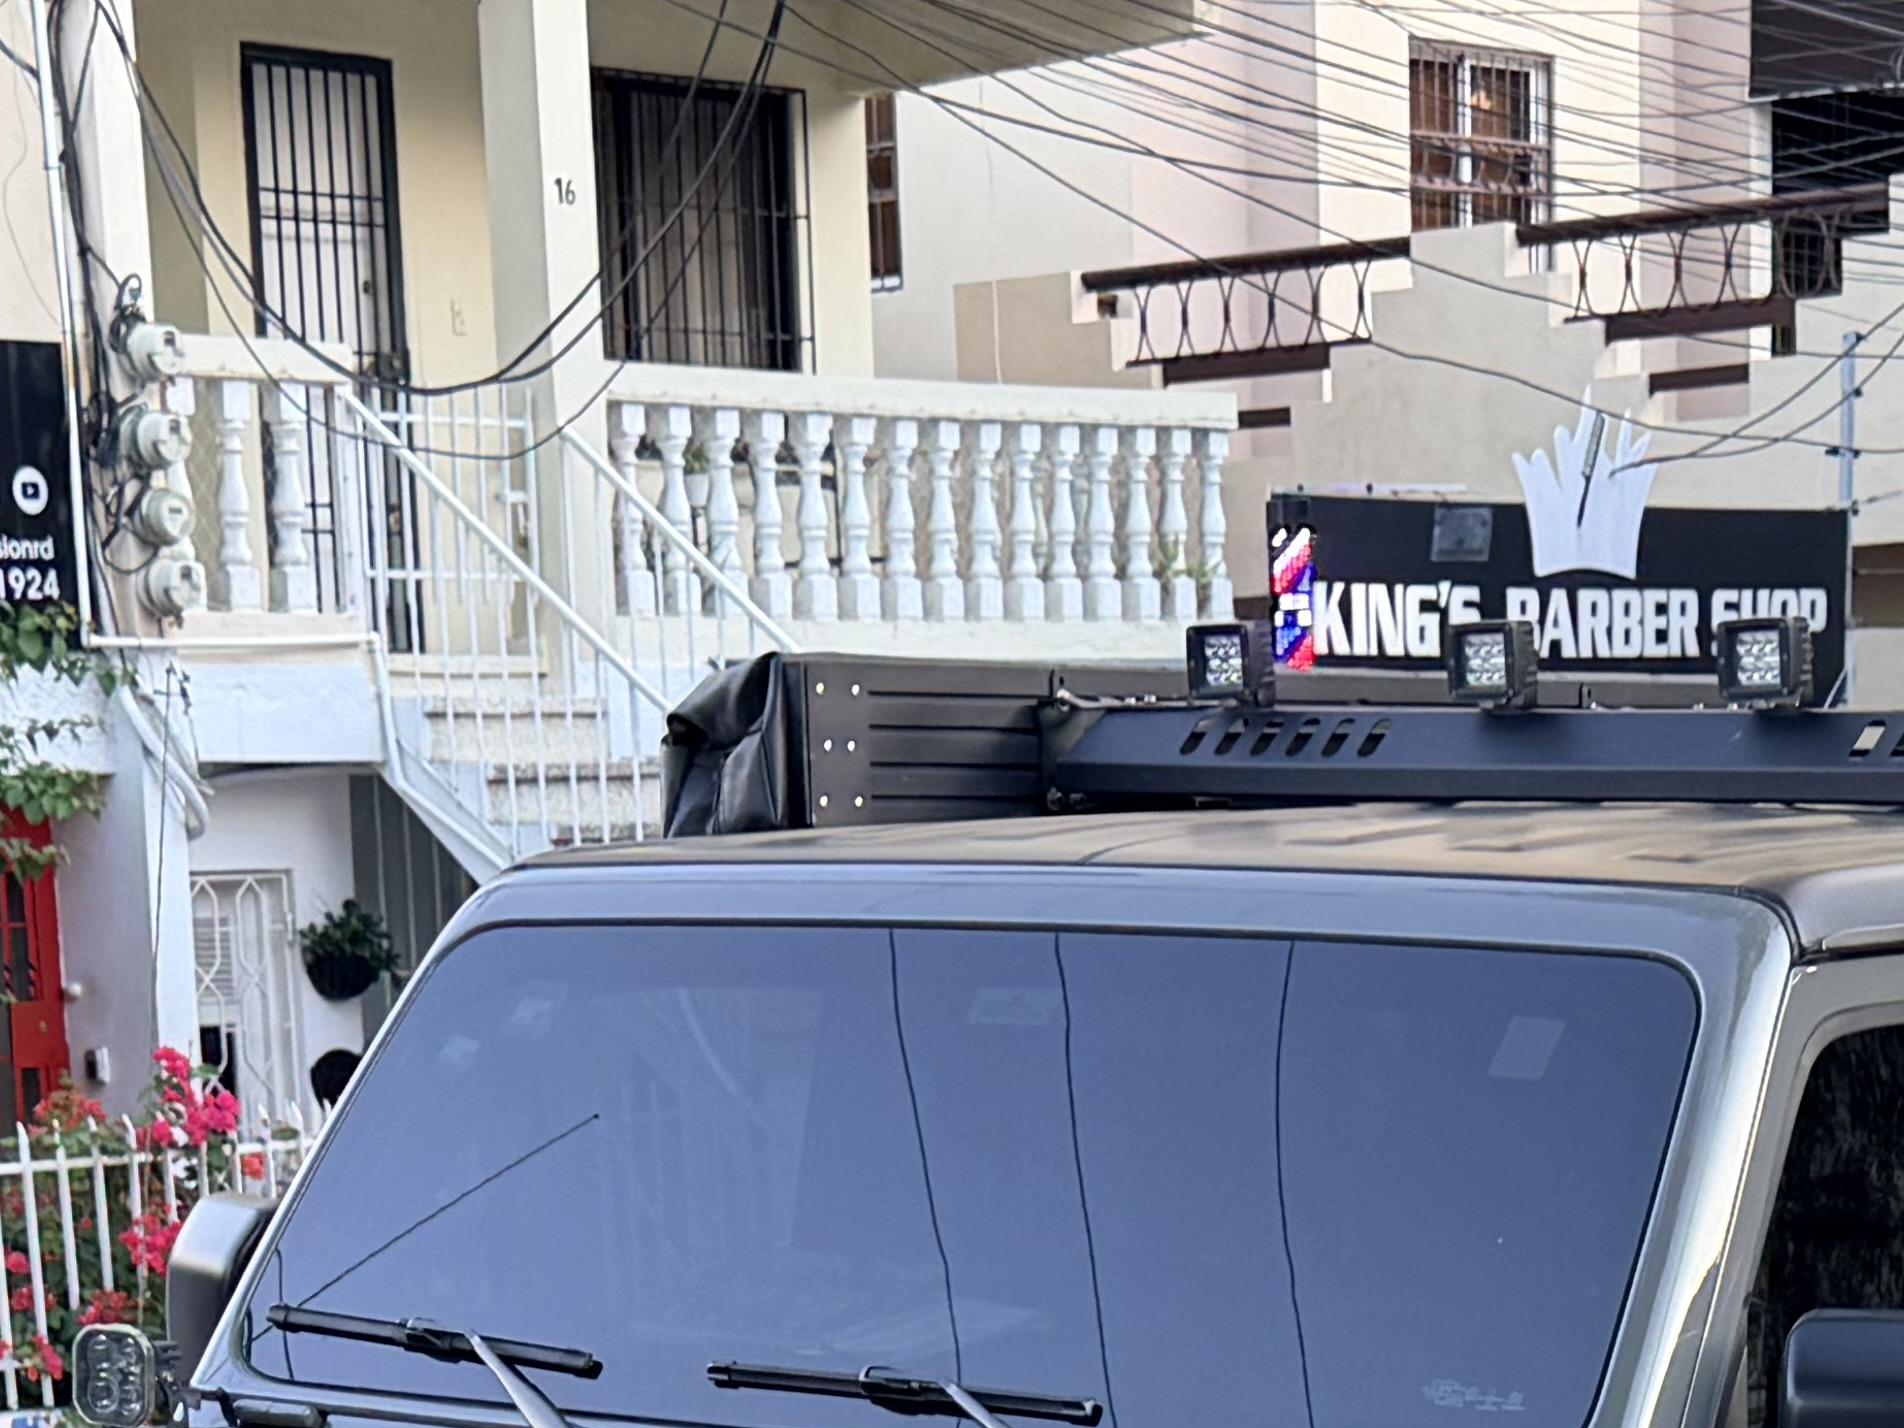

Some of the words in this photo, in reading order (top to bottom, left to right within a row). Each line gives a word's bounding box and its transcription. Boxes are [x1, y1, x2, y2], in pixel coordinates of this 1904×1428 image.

[554, 177, 576, 205] 16
[1313, 580, 1482, 658] KING'S
[1506, 587, 1700, 658] BARBER
